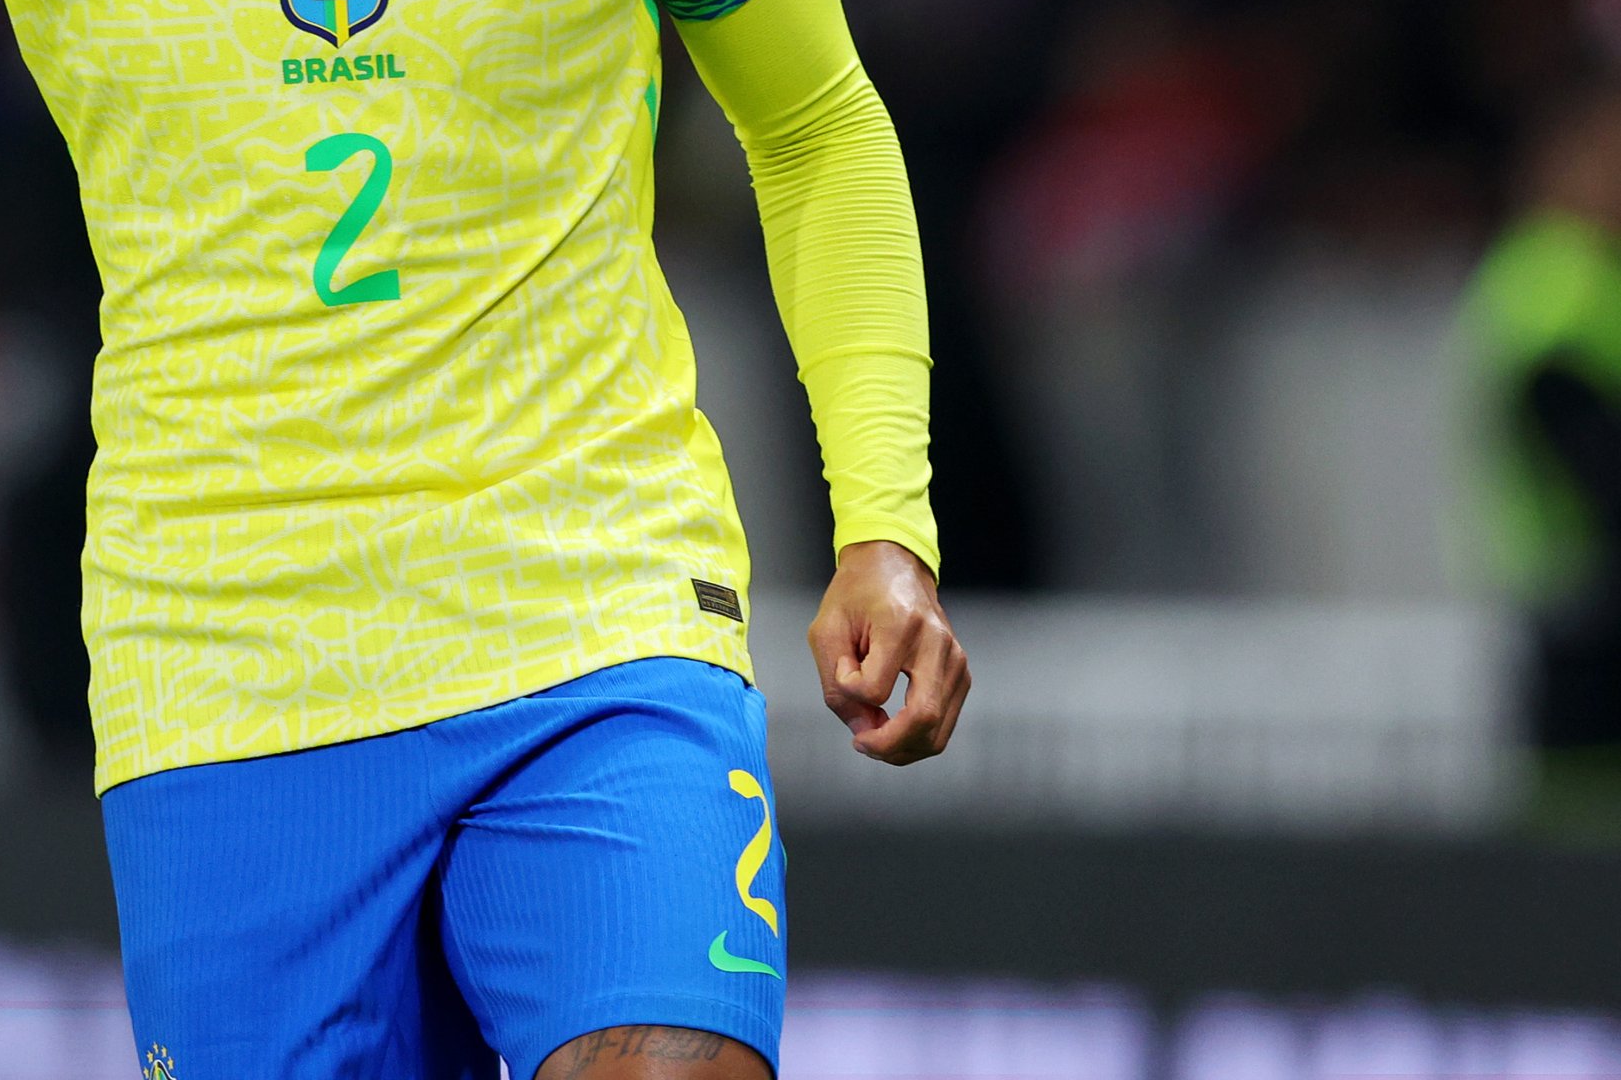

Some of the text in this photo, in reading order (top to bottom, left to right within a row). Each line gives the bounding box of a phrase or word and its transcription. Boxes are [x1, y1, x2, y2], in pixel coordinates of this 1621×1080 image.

[281, 53, 407, 85] BRASIL
[304, 132, 402, 307] 2
[727, 768, 779, 939] 2
